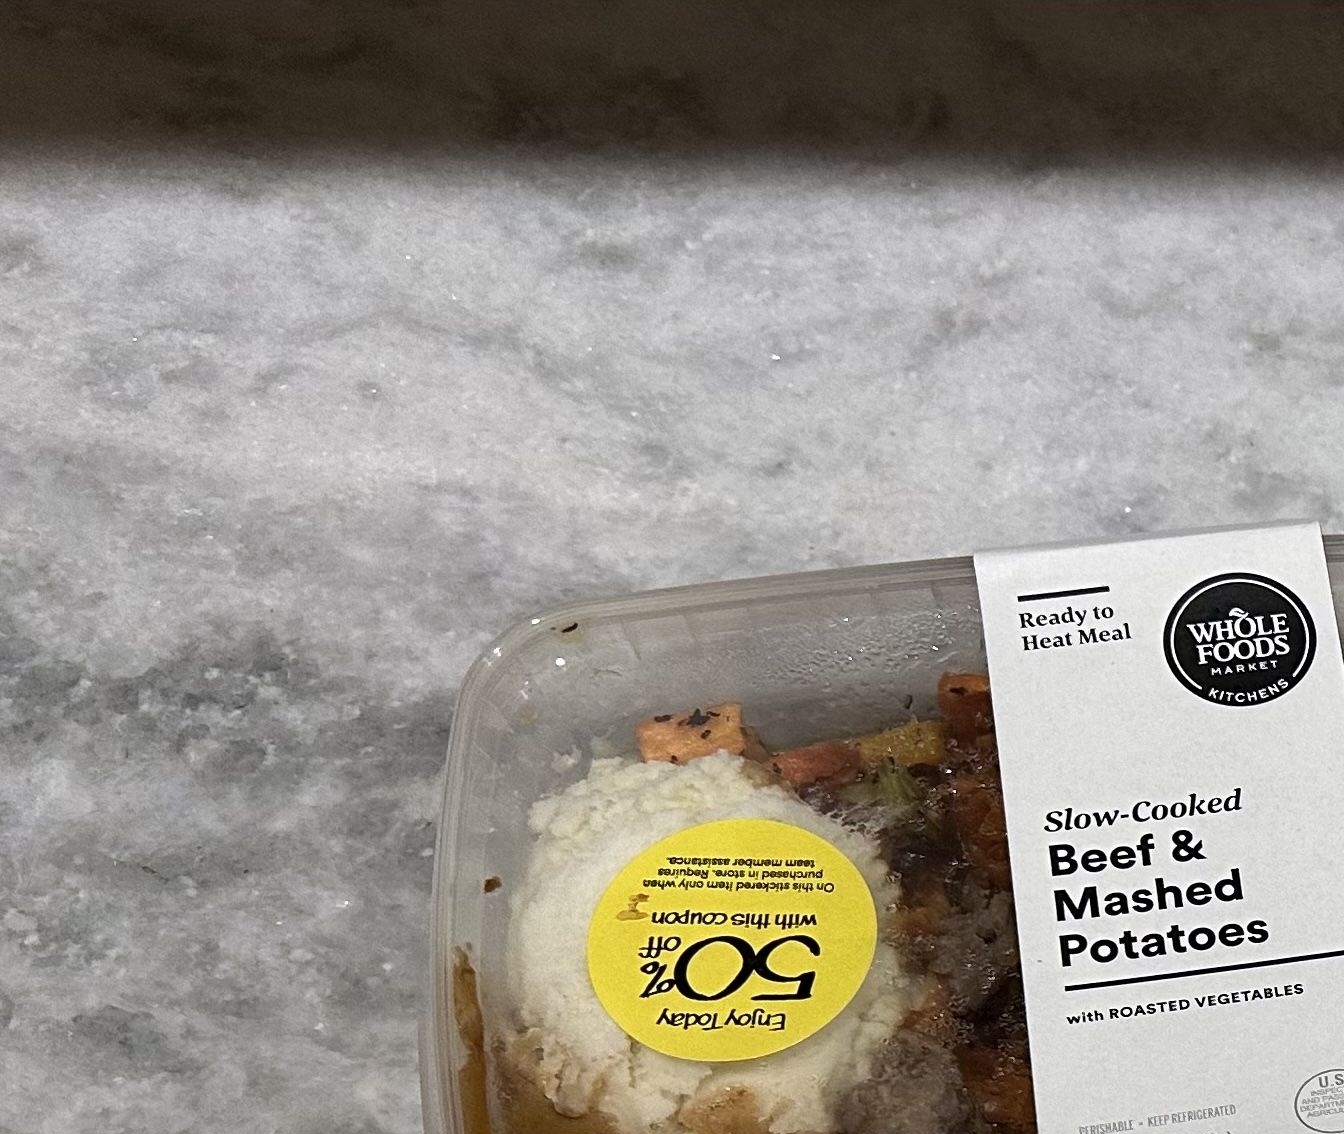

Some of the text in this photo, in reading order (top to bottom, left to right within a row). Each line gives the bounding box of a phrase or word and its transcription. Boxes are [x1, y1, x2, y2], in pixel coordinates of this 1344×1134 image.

[1019, 605, 1114, 629] Ready to
[1187, 612, 1290, 643] WHOLE
[1022, 624, 1132, 651] Heat Meal
[1197, 634, 1290, 665] FOODS
[1210, 660, 1278, 676] MARKET
[1208, 678, 1289, 703] KITCHENS
[1044, 788, 1242, 832] Slow-Cooked
[1049, 830, 1207, 876] Beef &
[1054, 868, 1244, 921] Mashed
[652, 910, 817, 930] with this coupon
[1059, 920, 1269, 967] Potatoes
[639, 935, 820, 1001] 50% off
[656, 1008, 786, 1031] Enjoy Today
[1066, 984, 1304, 1024] with ROASTED VEGETABLES
